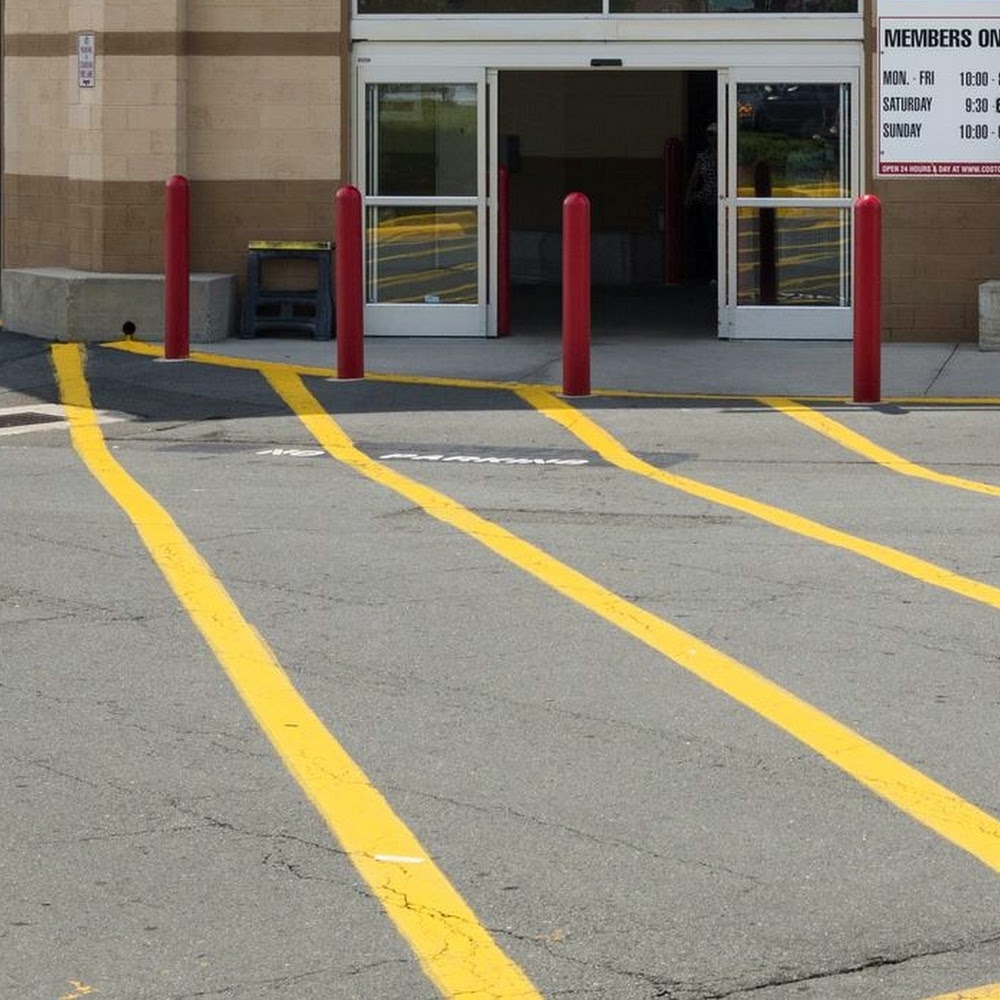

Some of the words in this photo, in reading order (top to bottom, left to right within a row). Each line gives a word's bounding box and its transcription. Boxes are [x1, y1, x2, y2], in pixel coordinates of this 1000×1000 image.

[884, 28, 972, 48] MEMBERS
[883, 70, 910, 86] MON.
[919, 70, 935, 86] FRI
[960, 71, 988, 87] 10:00
[883, 97, 933, 112] SATURDAY
[965, 97, 988, 113] 9:30
[883, 122, 922, 138] SUNDAY
[960, 124, 988, 139] 10:00
[882, 165, 899, 173] OPEN
[900, 165, 908, 173] 24
[909, 165, 932, 173] HOURS
[938, 165, 951, 173] DAY
[952, 165, 960, 173] AT
